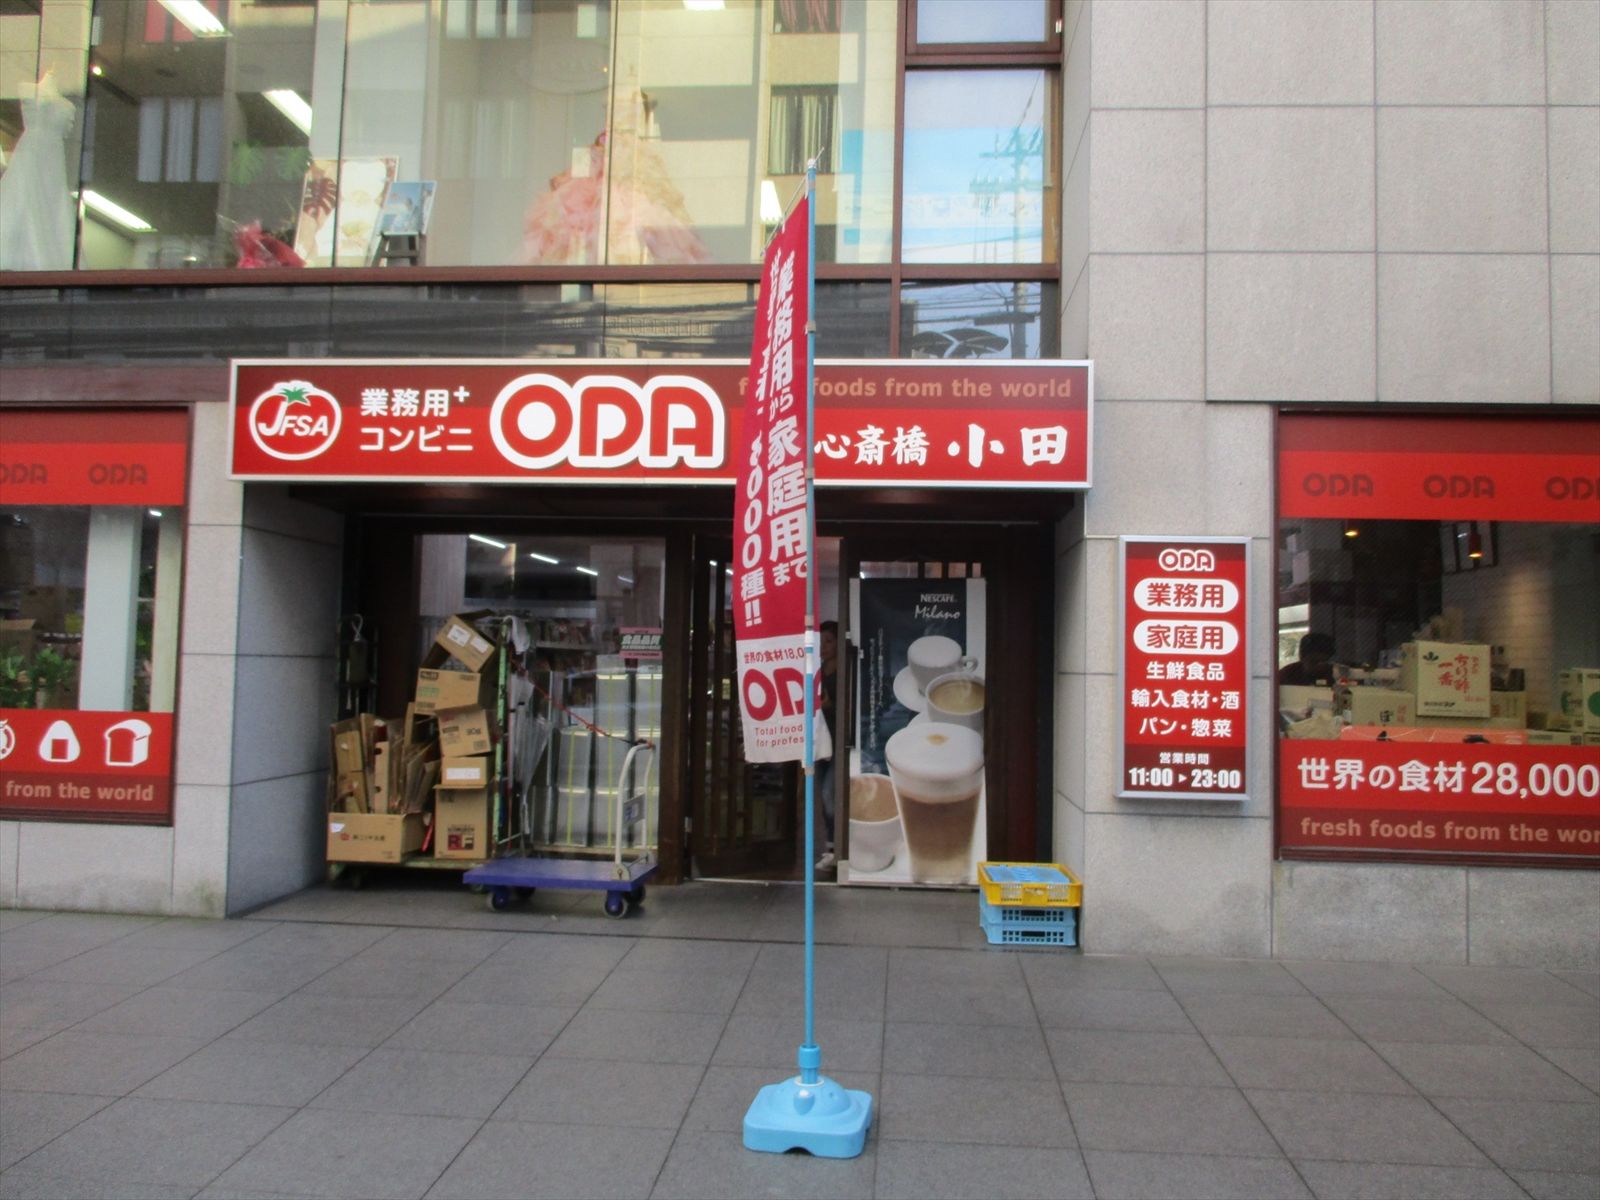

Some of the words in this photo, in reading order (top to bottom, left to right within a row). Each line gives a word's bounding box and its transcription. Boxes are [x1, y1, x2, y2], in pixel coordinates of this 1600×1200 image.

[885, 377, 943, 397] from
[951, 377, 993, 397] the
[1001, 379, 1072, 398] world
[258, 398, 329, 437] JFSA
[489, 373, 726, 469] ODA
[360, 426, 474, 453] コンビニ
[947, 423, 1068, 468] 小田
[88, 463, 148, 485] ODA
[1303, 473, 1374, 498] ODA
[1423, 475, 1495, 499] ODA
[1545, 476, 1600, 501] OD
[1158, 548, 1215, 572] ODA
[1147, 582, 1225, 608] 業務用
[914, 604, 961, 620] Milano
[1146, 624, 1224, 650] 家庭用
[1146, 661, 1225, 681] 生鮮食品
[1131, 688, 1240, 710] 輸入食材・酒
[1159, 752, 1210, 765] 営業時間
[1128, 767, 1174, 787] 11:00
[1190, 768, 1241, 788] 23:00
[6, 780, 51, 797] from
[58, 782, 91, 799] the
[97, 784, 154, 801] world
[1300, 817, 1361, 837] fresh
[1370, 819, 1436, 839] foods
[1444, 821, 1500, 840] from
[1509, 824, 1549, 842] the
